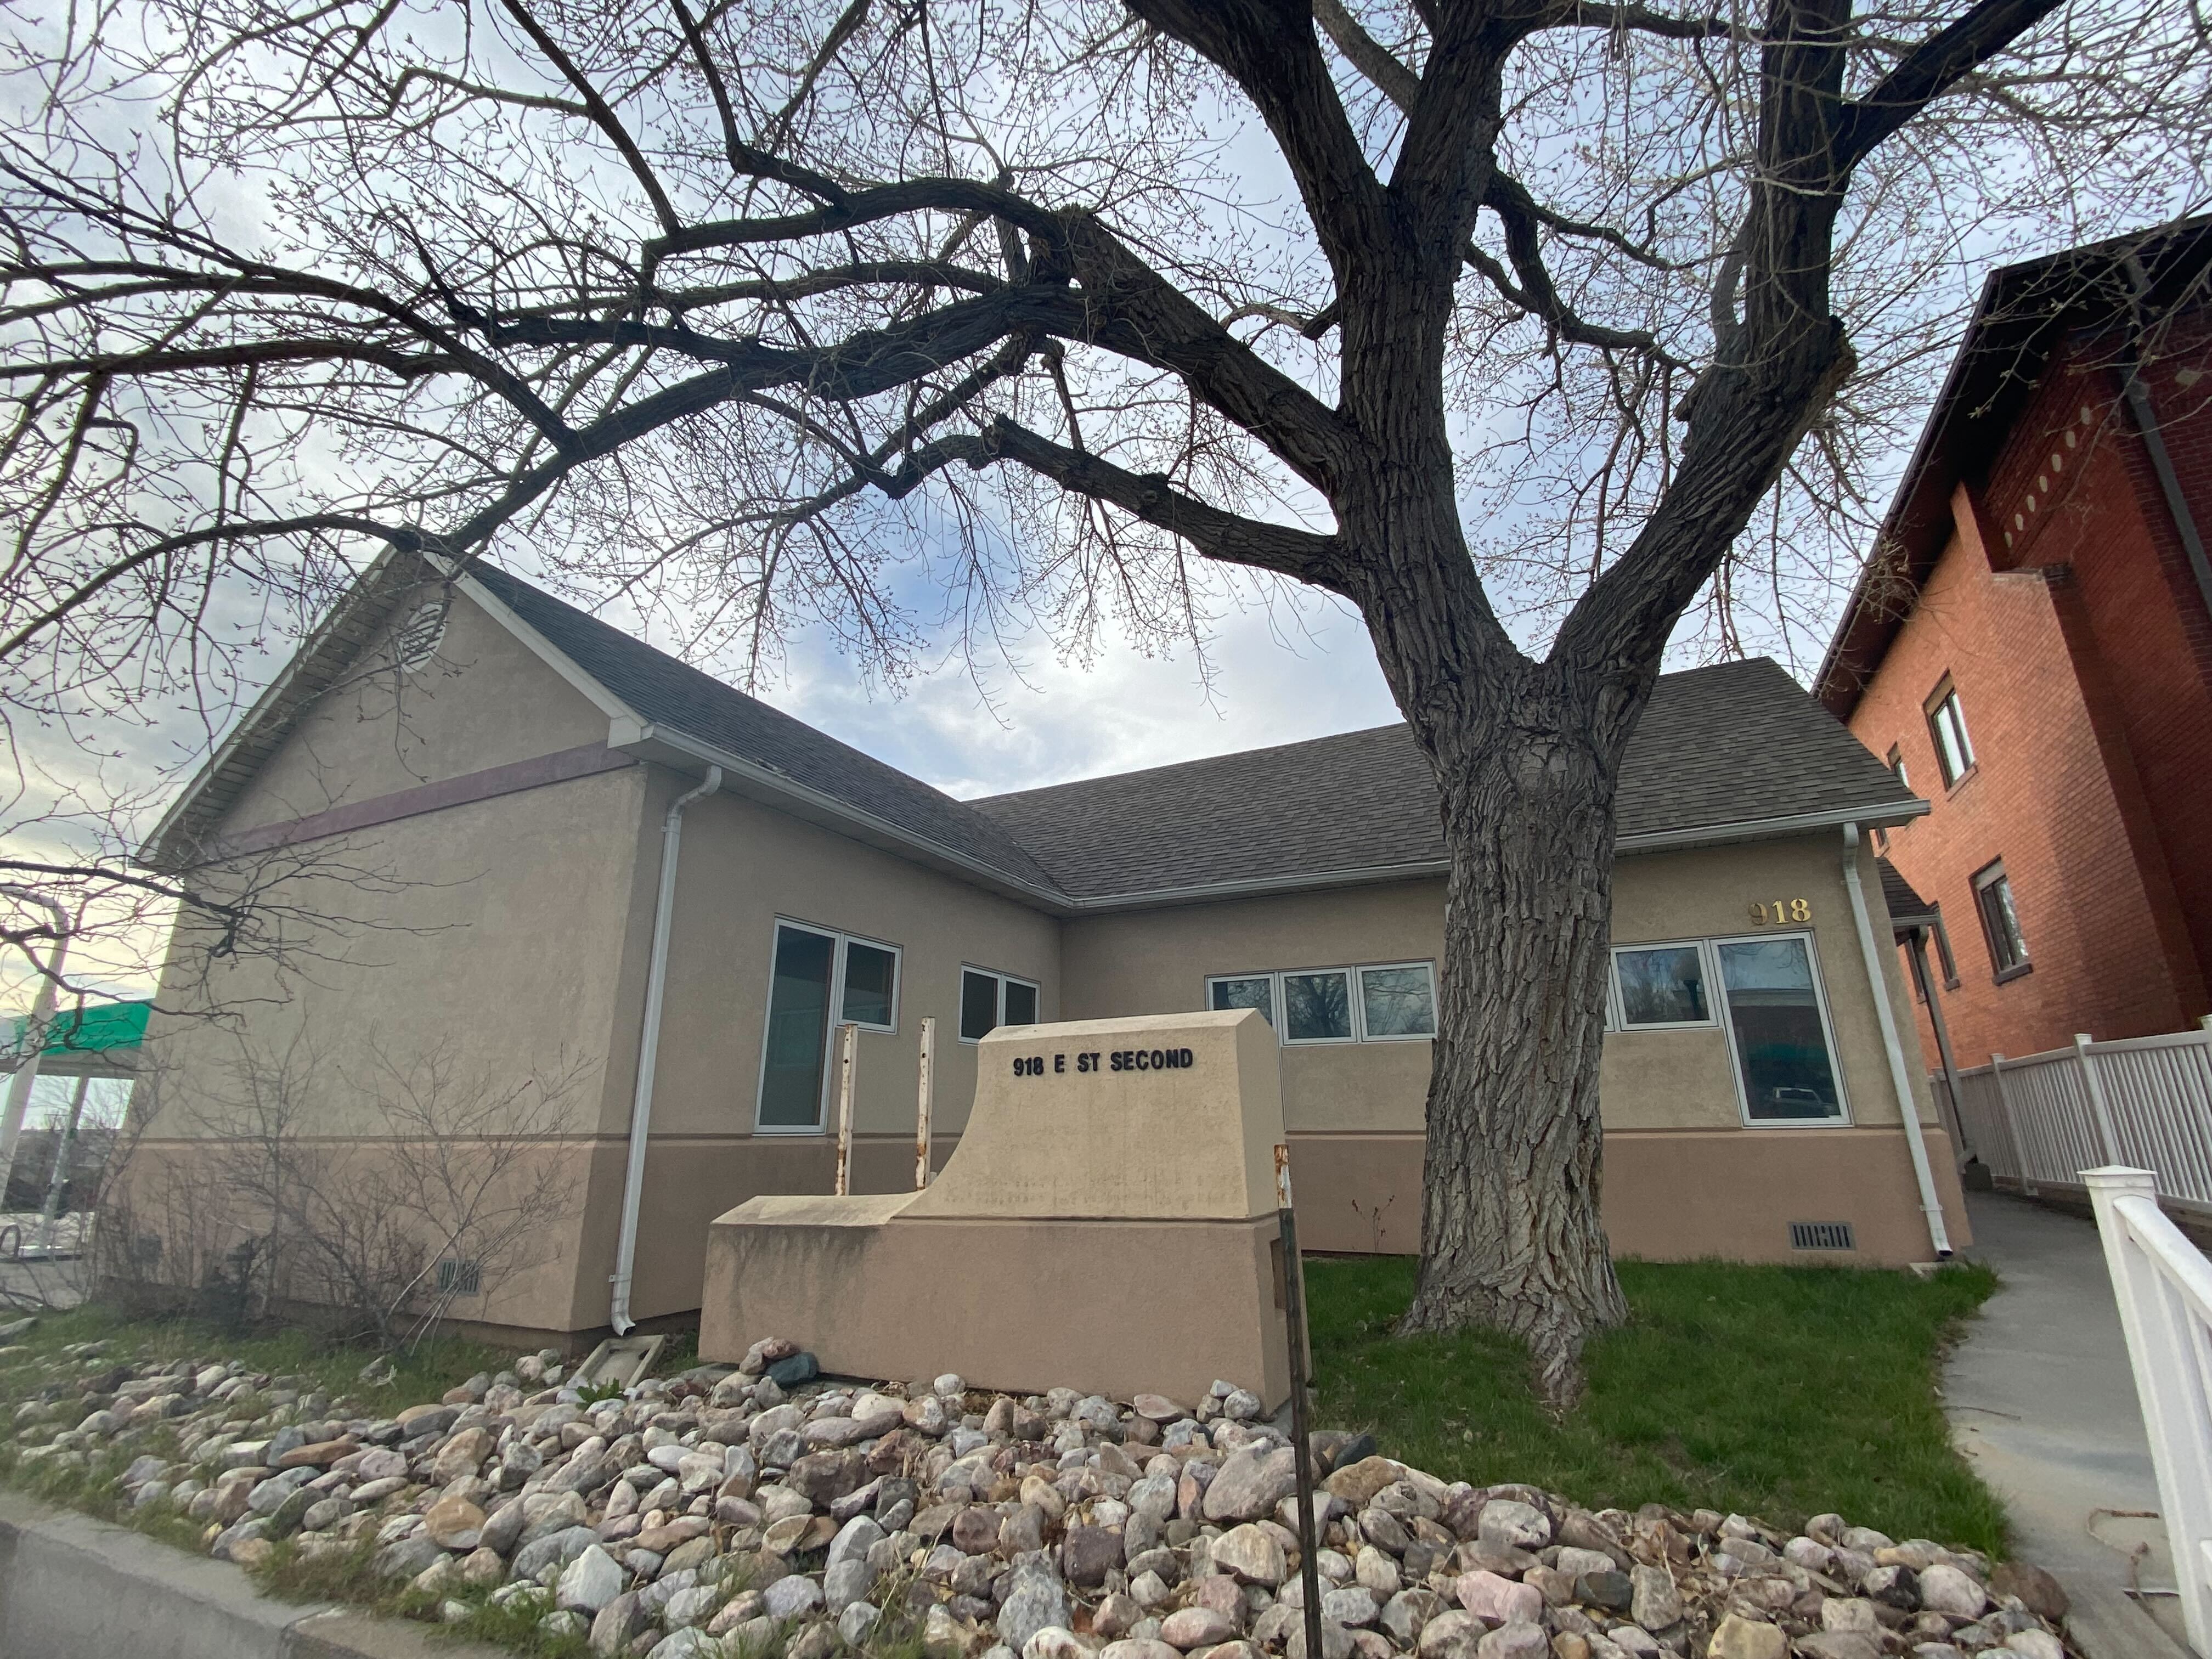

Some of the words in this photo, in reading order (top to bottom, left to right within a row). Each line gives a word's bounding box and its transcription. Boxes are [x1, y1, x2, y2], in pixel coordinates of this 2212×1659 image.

[1748, 898, 1812, 926] 918
[1013, 1057, 1044, 1076] 918
[1054, 1054, 1065, 1073] E
[1077, 1053, 1101, 1073] ST
[1110, 1048, 1193, 1071] SECOND
